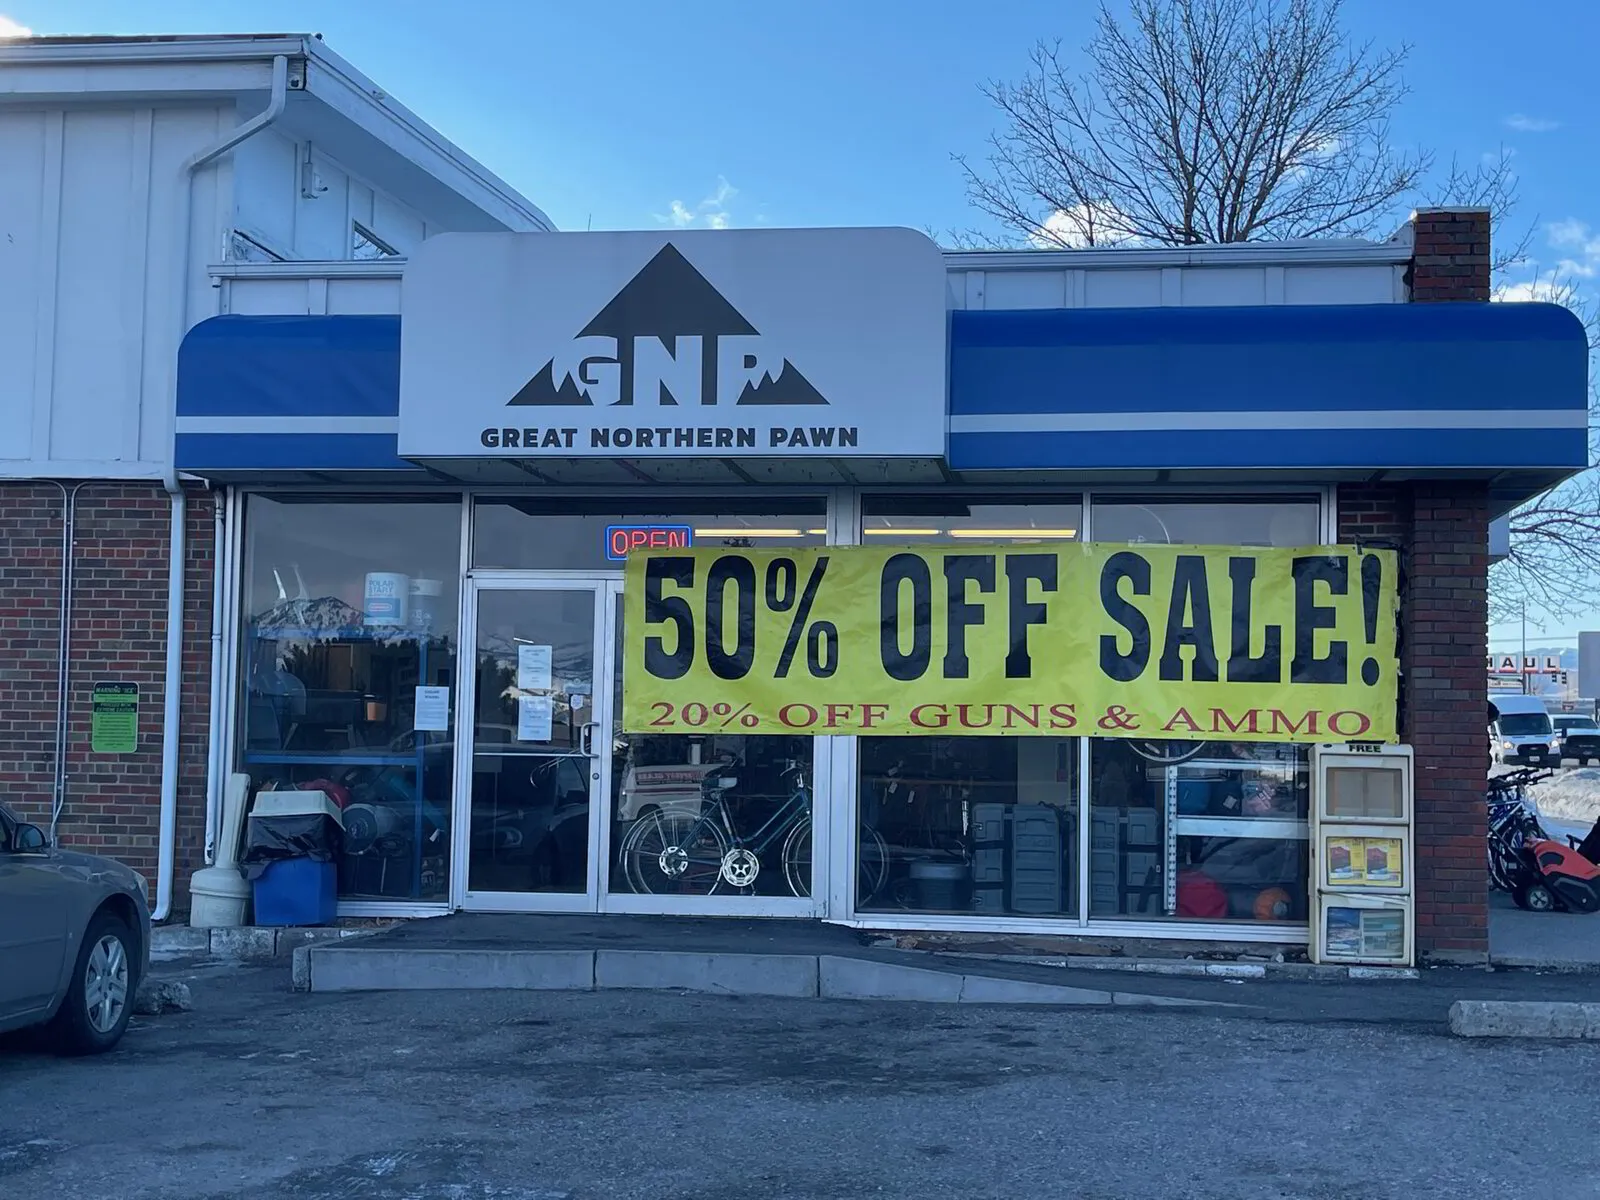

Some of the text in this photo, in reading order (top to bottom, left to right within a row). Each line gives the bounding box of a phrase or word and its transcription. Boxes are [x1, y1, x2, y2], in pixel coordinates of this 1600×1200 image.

[552, 335, 786, 405] GNP
[481, 427, 858, 448] GREAT NORTHERN PAWN
[612, 530, 686, 555] OPEN
[644, 551, 1382, 687] 50% OFF SALE!
[649, 702, 1372, 737] 20% OFF GUNS & AMMO
[1348, 744, 1382, 753] FREE
